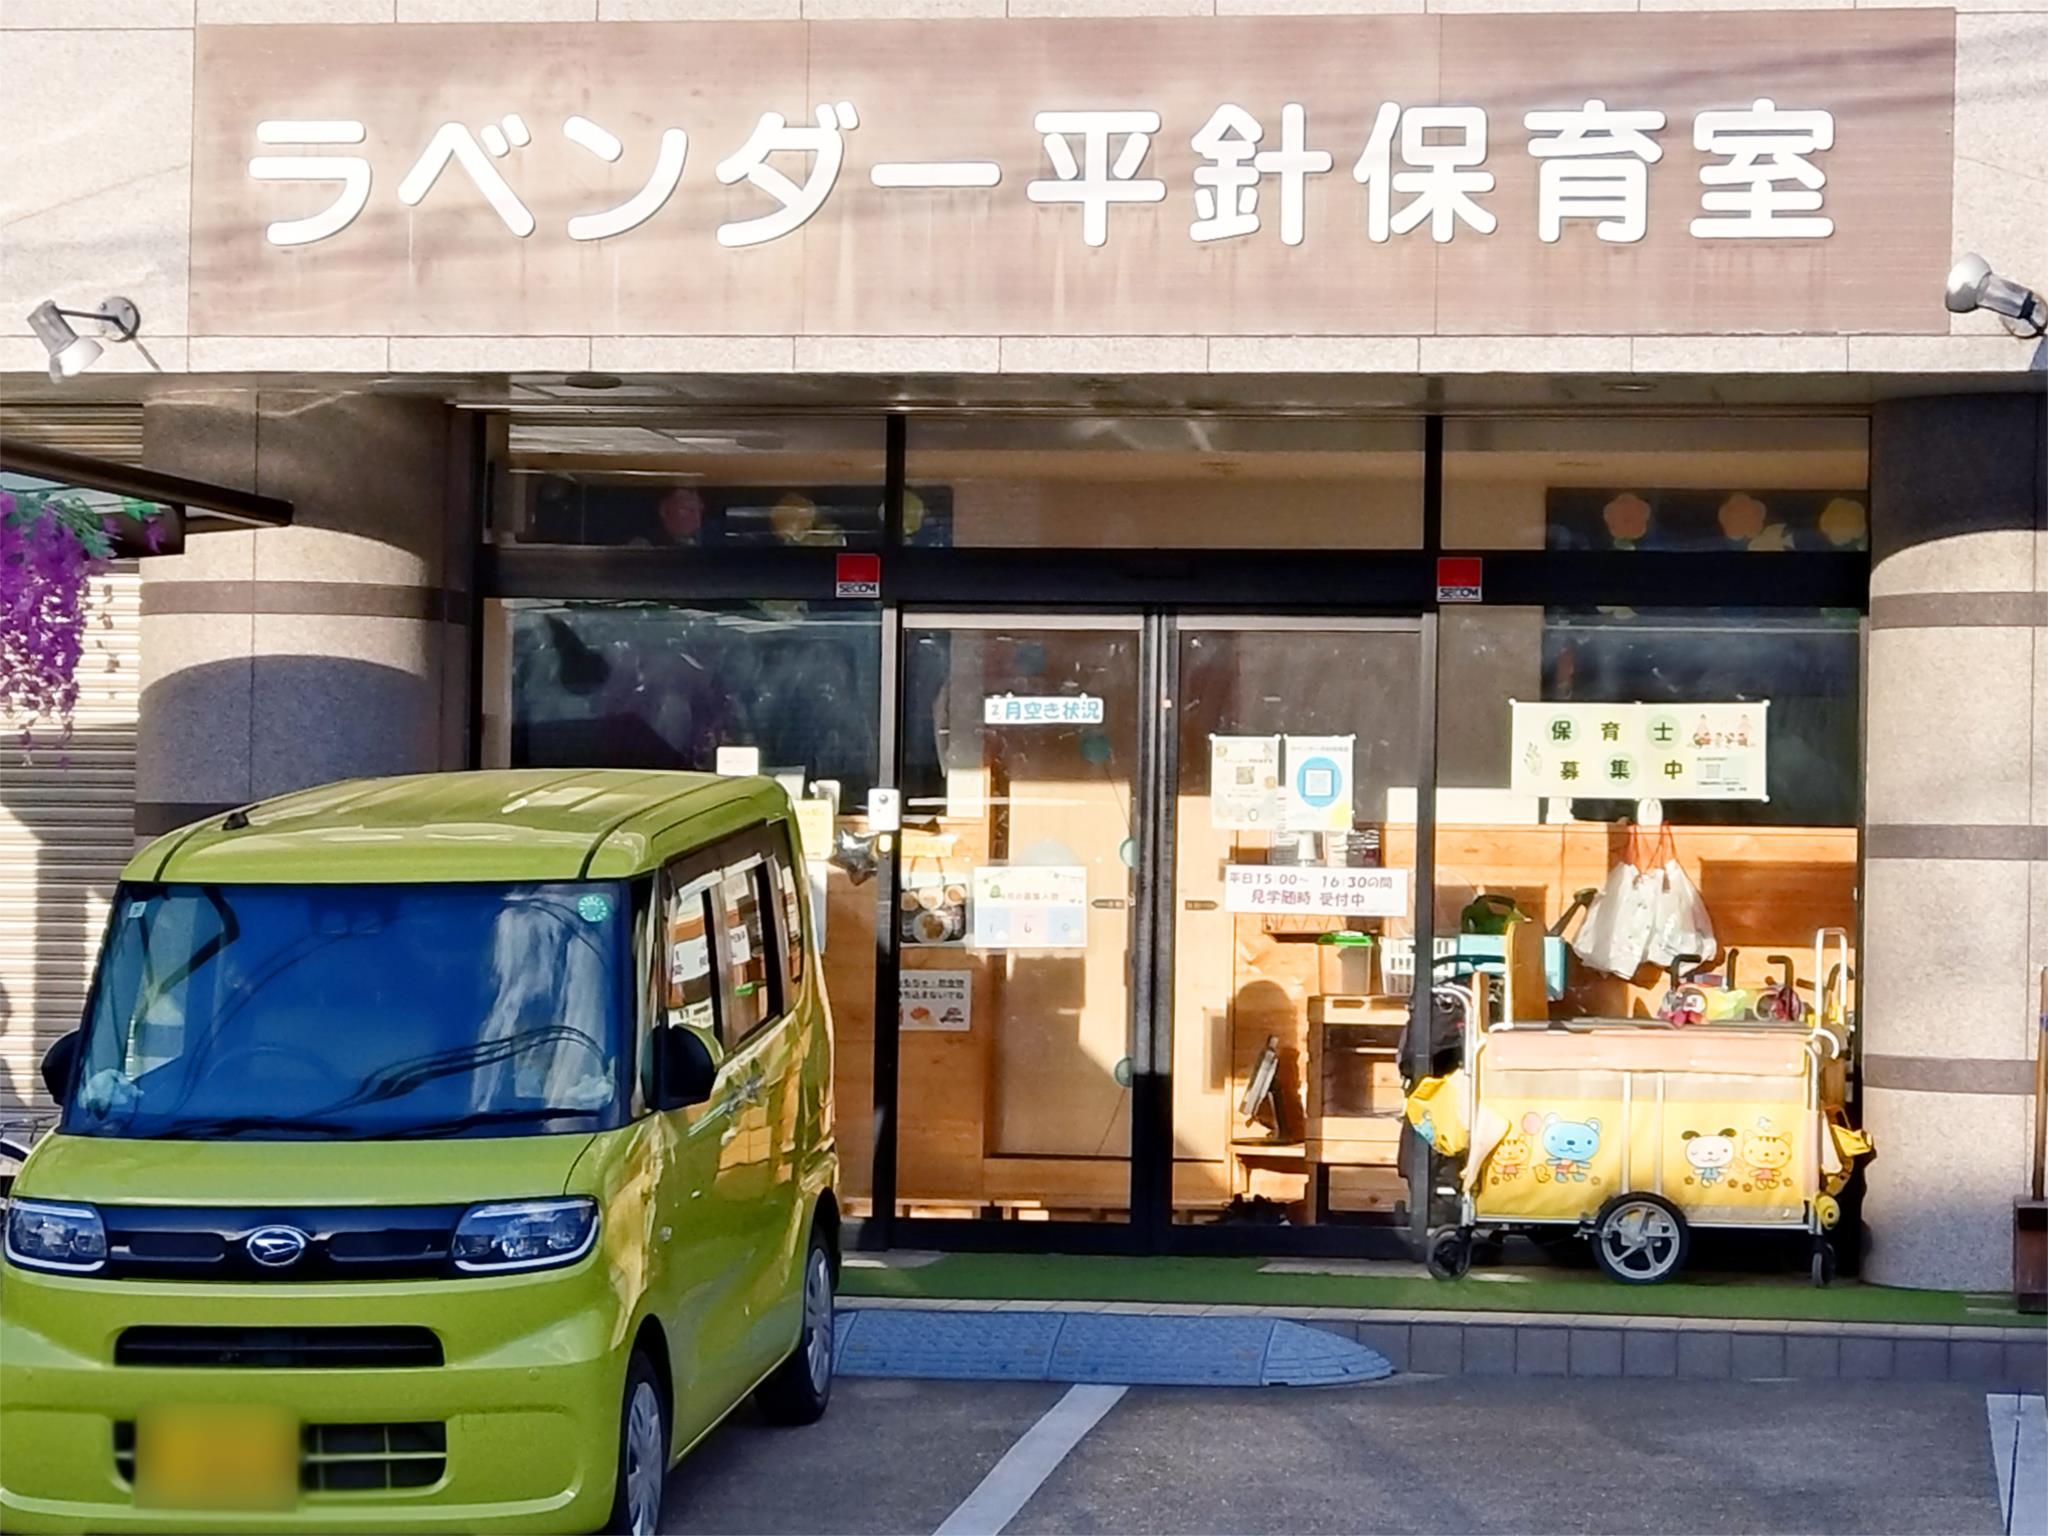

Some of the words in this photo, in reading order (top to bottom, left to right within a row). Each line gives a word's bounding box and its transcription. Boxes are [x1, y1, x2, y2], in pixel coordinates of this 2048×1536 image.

[248, 98, 1835, 246] ラベンダー平針保育室
[1551, 720, 1674, 742] 保育士
[1560, 759, 1683, 780] 募集中
[1251, 889, 1311, 905] 見学随時
[1319, 892, 1365, 907] 受付中
